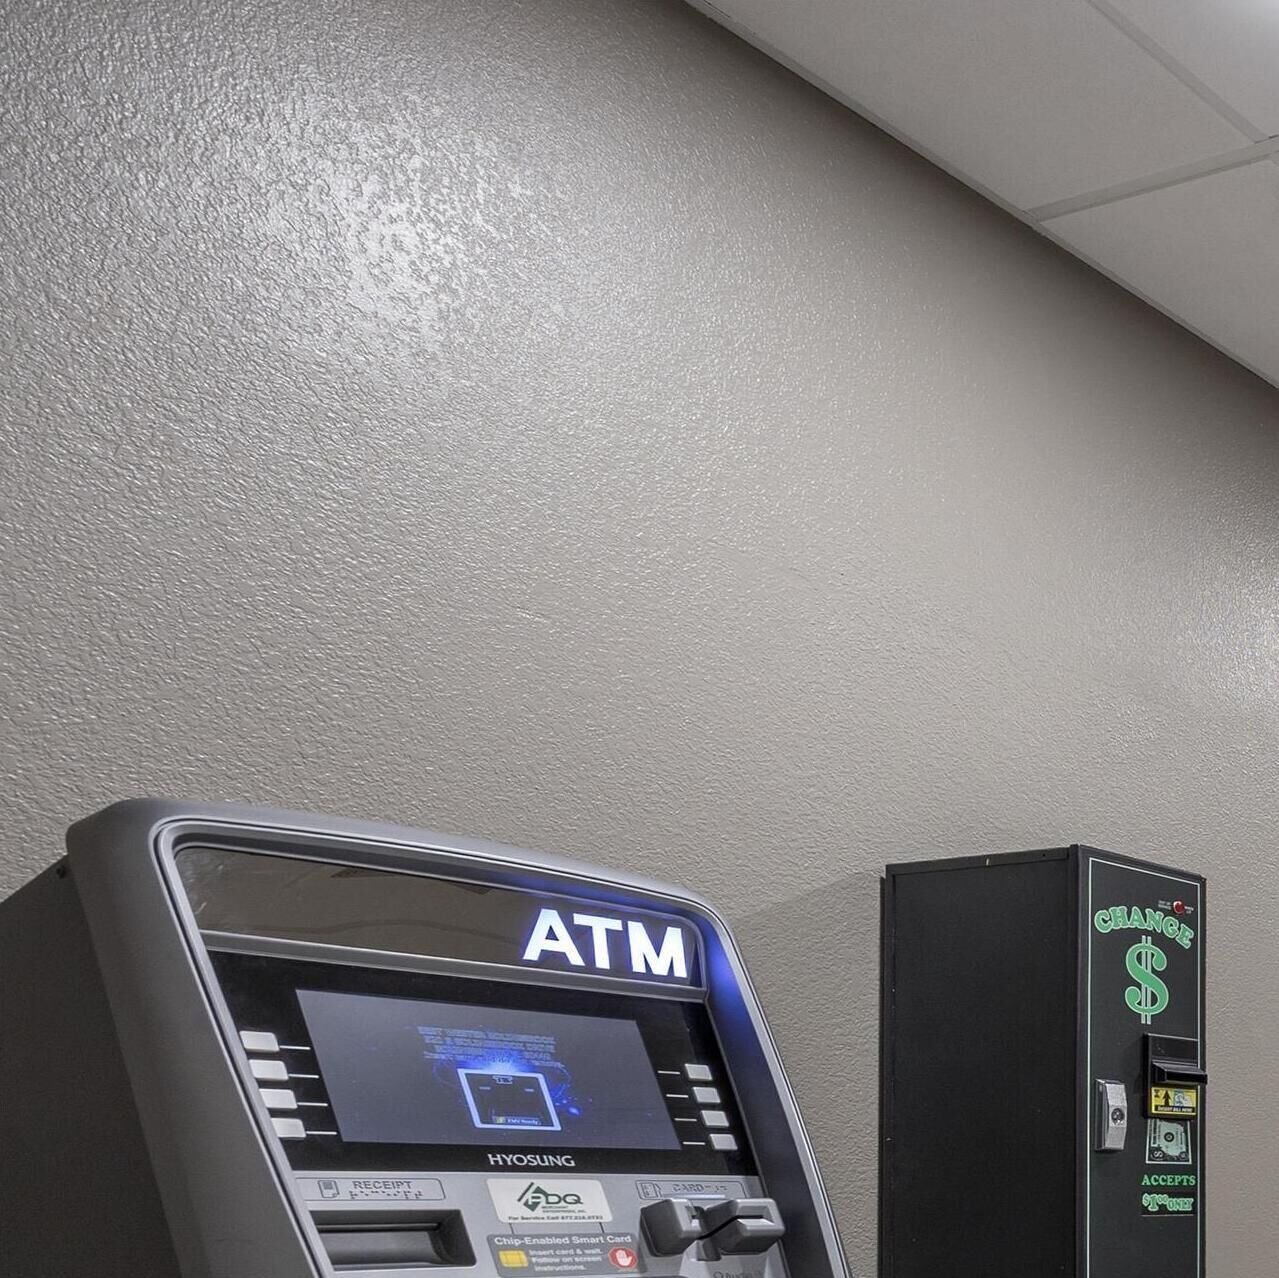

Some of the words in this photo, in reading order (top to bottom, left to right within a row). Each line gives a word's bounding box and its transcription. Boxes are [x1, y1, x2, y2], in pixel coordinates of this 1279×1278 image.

[1094, 906, 1194, 949] CHANGE
[522, 908, 688, 978] ATM
[488, 1153, 576, 1166] HYOSUNG
[352, 1181, 412, 1189] RECEIPT
[1142, 1175, 1195, 1185] ACCEPTS
[1167, 1198, 1194, 1211] ONLY
[494, 1237, 570, 1245] Chip-Enabled
[572, 1236, 604, 1244] Smart
